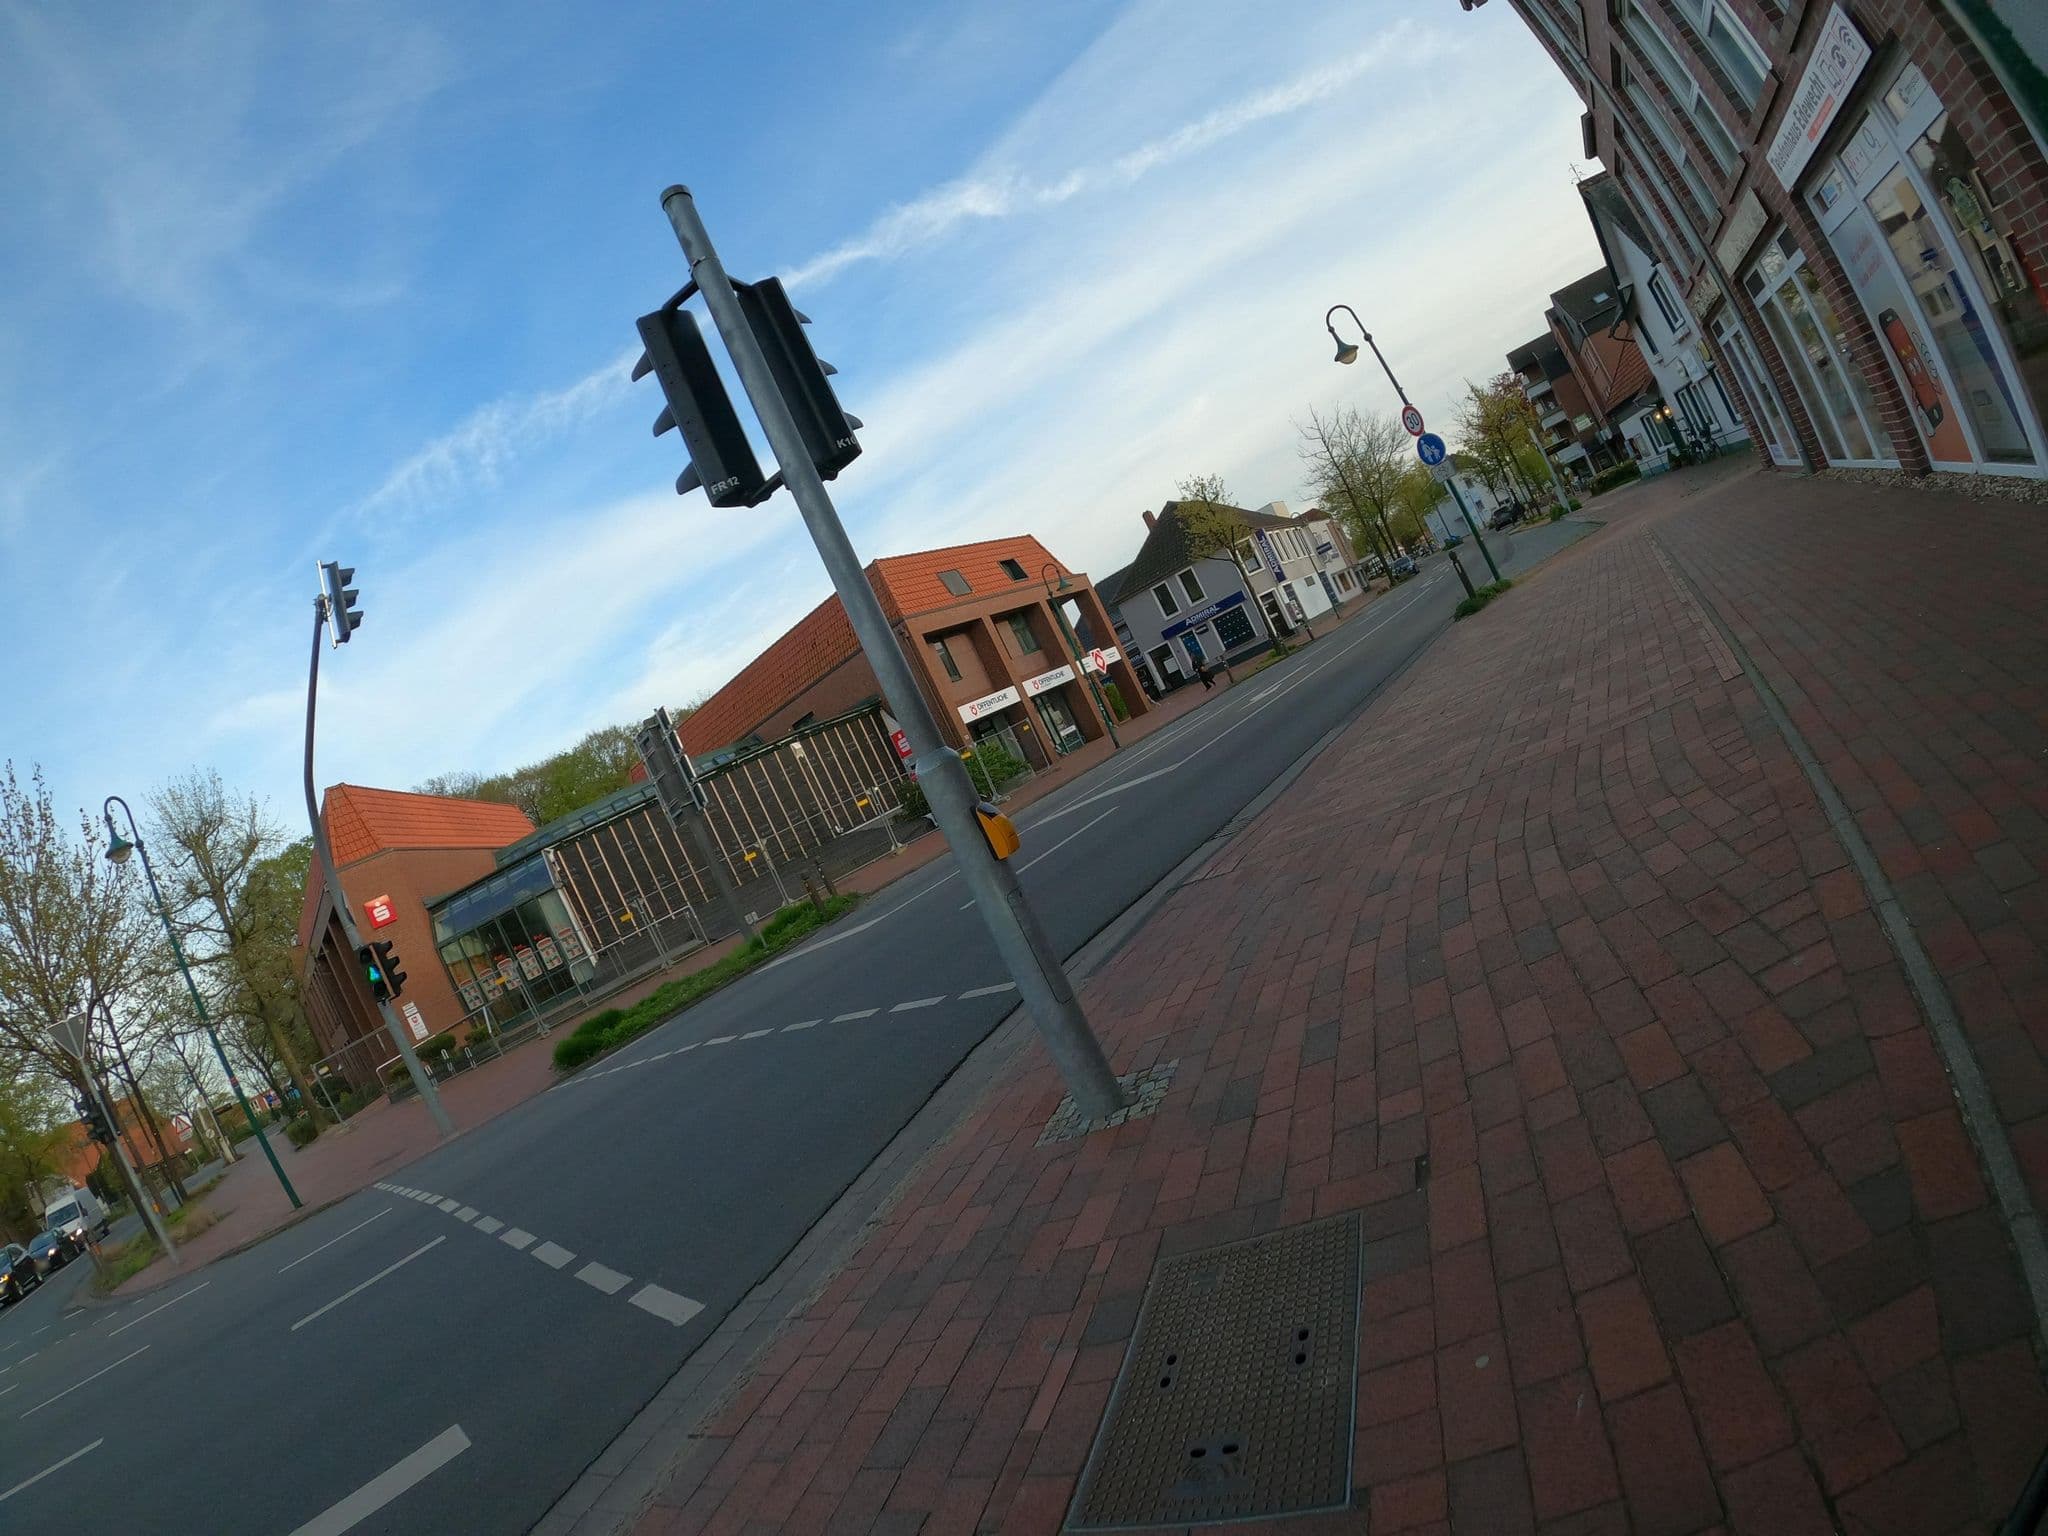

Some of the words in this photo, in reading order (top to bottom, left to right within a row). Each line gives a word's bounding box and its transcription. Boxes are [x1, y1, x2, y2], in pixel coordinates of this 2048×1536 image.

[1793, 71, 1827, 130] Edewecht
[1406, 413, 1420, 429] 30
[1185, 604, 1220, 627] ADMIRAL
